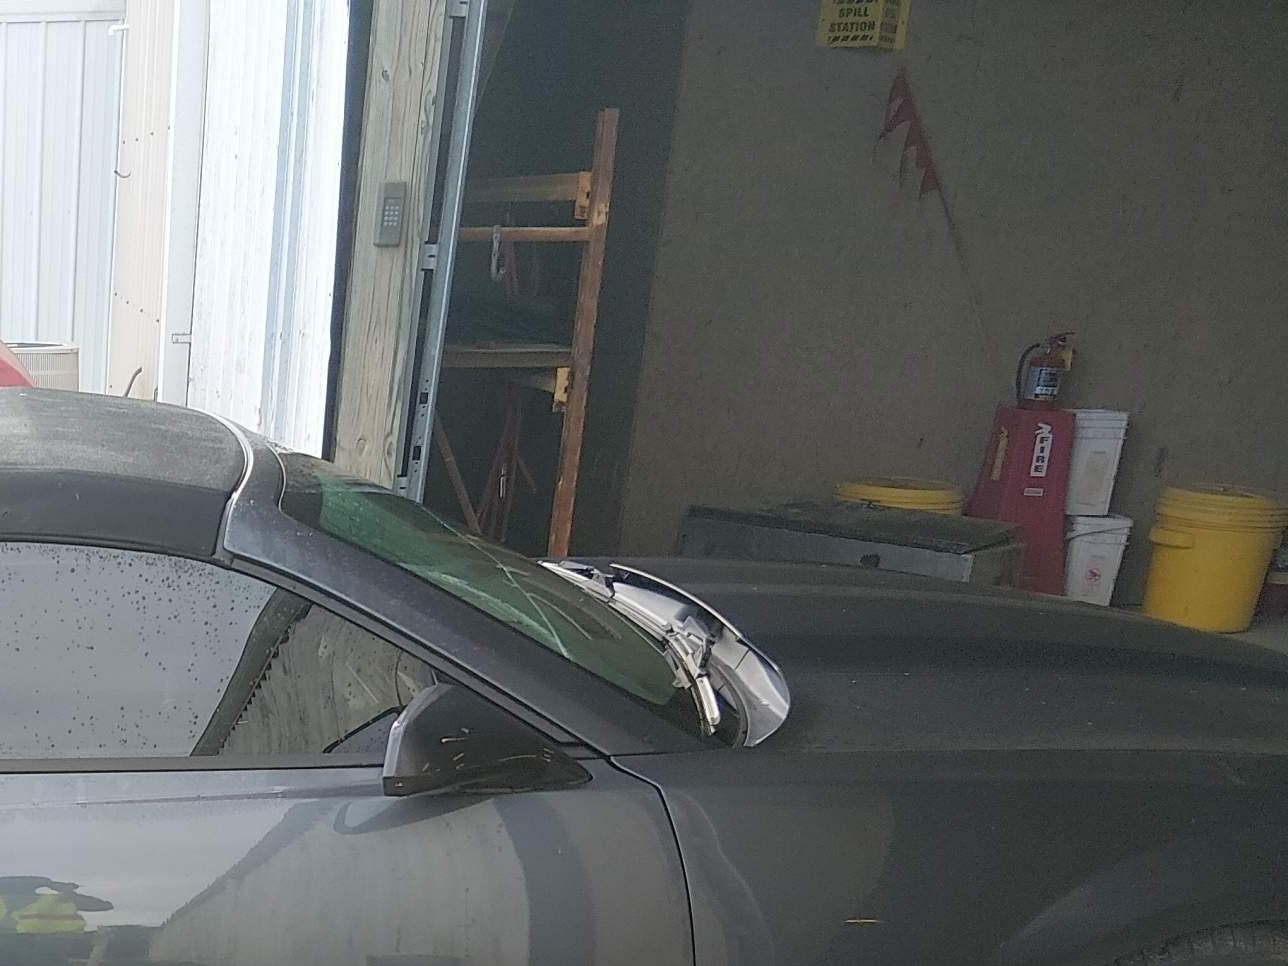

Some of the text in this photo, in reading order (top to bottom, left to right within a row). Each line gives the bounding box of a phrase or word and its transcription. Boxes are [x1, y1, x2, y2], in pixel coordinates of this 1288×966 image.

[839, 6, 869, 18] SPILL
[828, 20, 875, 33] STATION
[1033, 436, 1049, 473] FIRE
